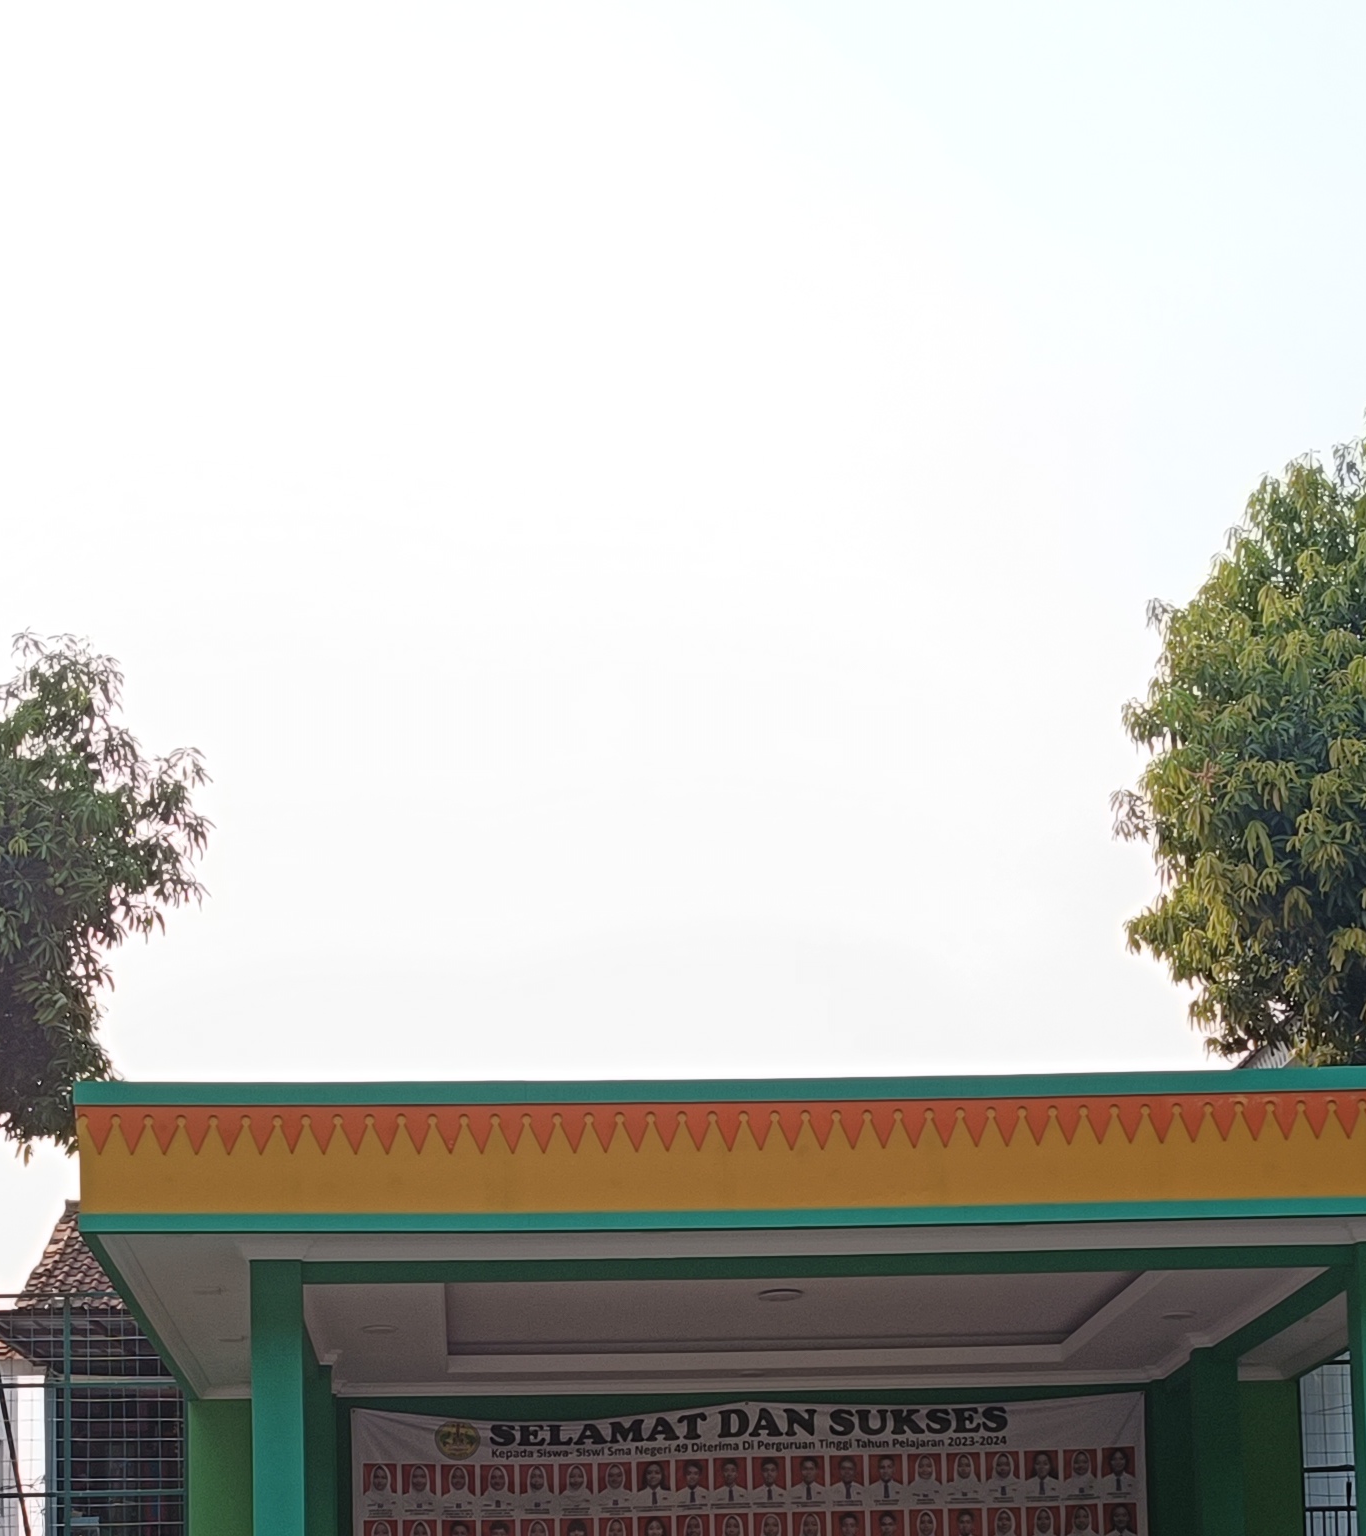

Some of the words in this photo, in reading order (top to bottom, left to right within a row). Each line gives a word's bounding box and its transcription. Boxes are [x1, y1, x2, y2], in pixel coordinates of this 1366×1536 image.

[489, 1411, 707, 1447] SELAMAT
[717, 1407, 817, 1438] DAN
[829, 1406, 1008, 1438] SUKSES
[491, 1447, 535, 1460] Kepada
[536, 1447, 573, 1459] Siswa-
[575, 1446, 606, 1457] Siswi
[607, 1446, 632, 1456] Sma
[634, 1444, 672, 1458] Negeri
[673, 1443, 688, 1454] 49
[691, 1441, 740, 1453] Diterima
[742, 1439, 755, 1451] Di
[757, 1440, 816, 1453] Perguruan
[818, 1439, 852, 1451] Tinggi
[854, 1438, 890, 1449] Tahun
[892, 1437, 945, 1450] Pelajaran
[947, 1436, 1008, 1448] 2023-2024
